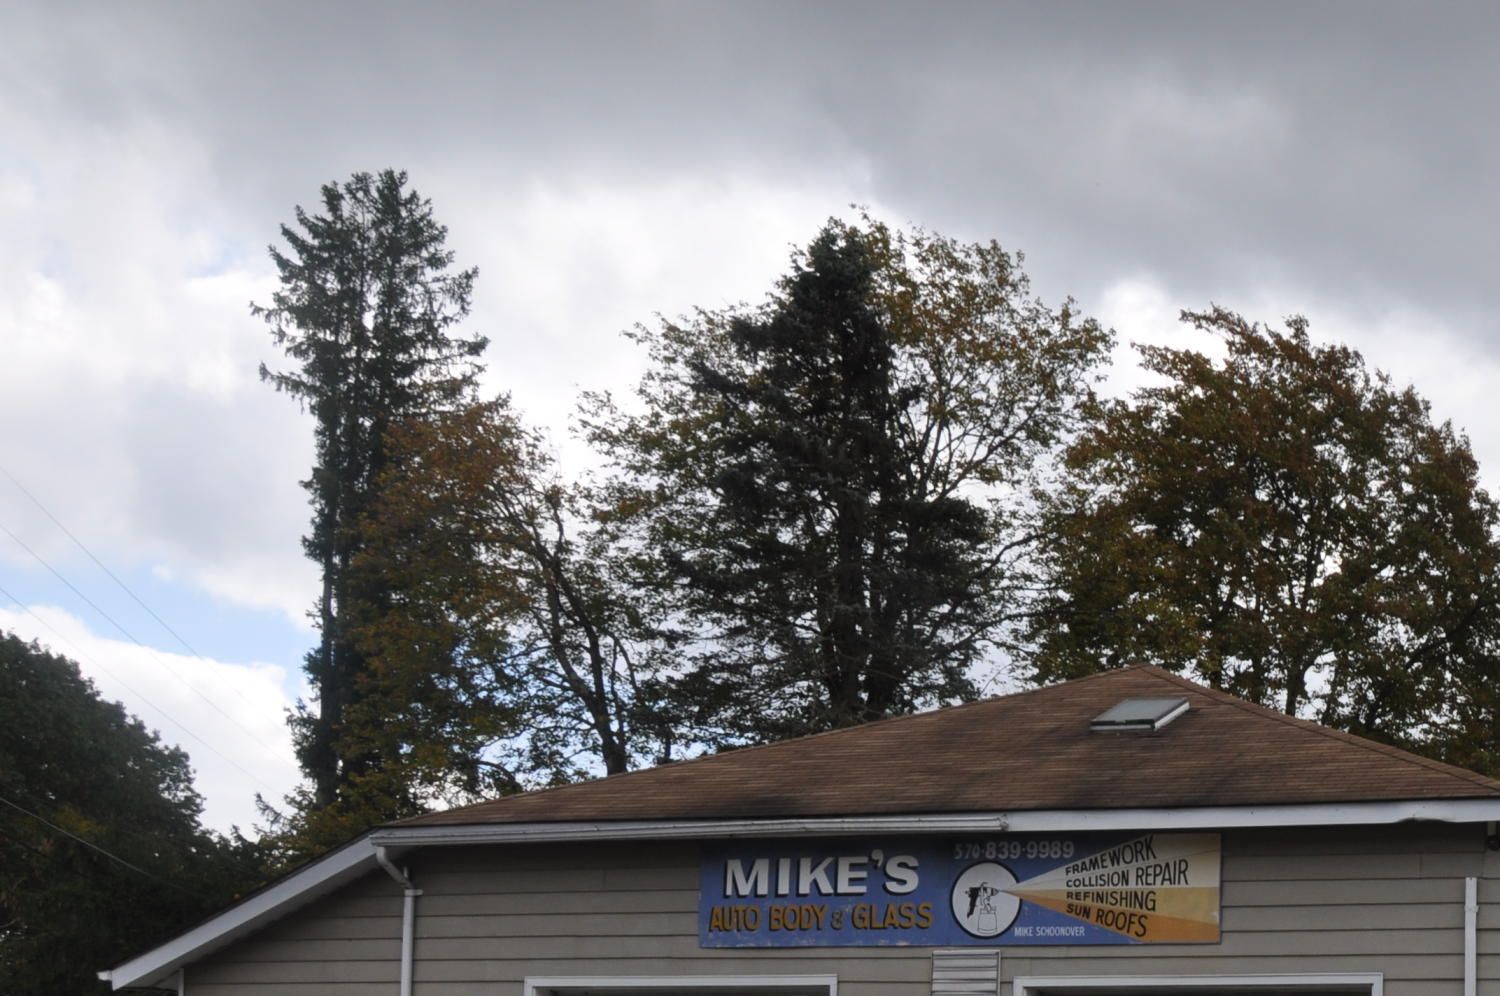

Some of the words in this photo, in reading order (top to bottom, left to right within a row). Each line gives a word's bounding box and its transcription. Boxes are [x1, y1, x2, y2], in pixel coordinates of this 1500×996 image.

[1065, 836, 1157, 876] FRAMEWORK
[724, 849, 920, 897] MIKE'S
[1065, 868, 1130, 888] COLLISION
[1135, 858, 1190, 887] REPAIR
[1066, 890, 1156, 912] REFINISHING
[709, 904, 761, 932] AUTO
[769, 904, 827, 931] BODY
[830, 909, 848, 930] &
[852, 903, 934, 930] GLASS
[1014, 926, 1034, 937] MIKE
[1035, 926, 1086, 937] SCHOONOVER
[1065, 903, 1091, 921] SUN
[1095, 909, 1149, 938] ROOFS
